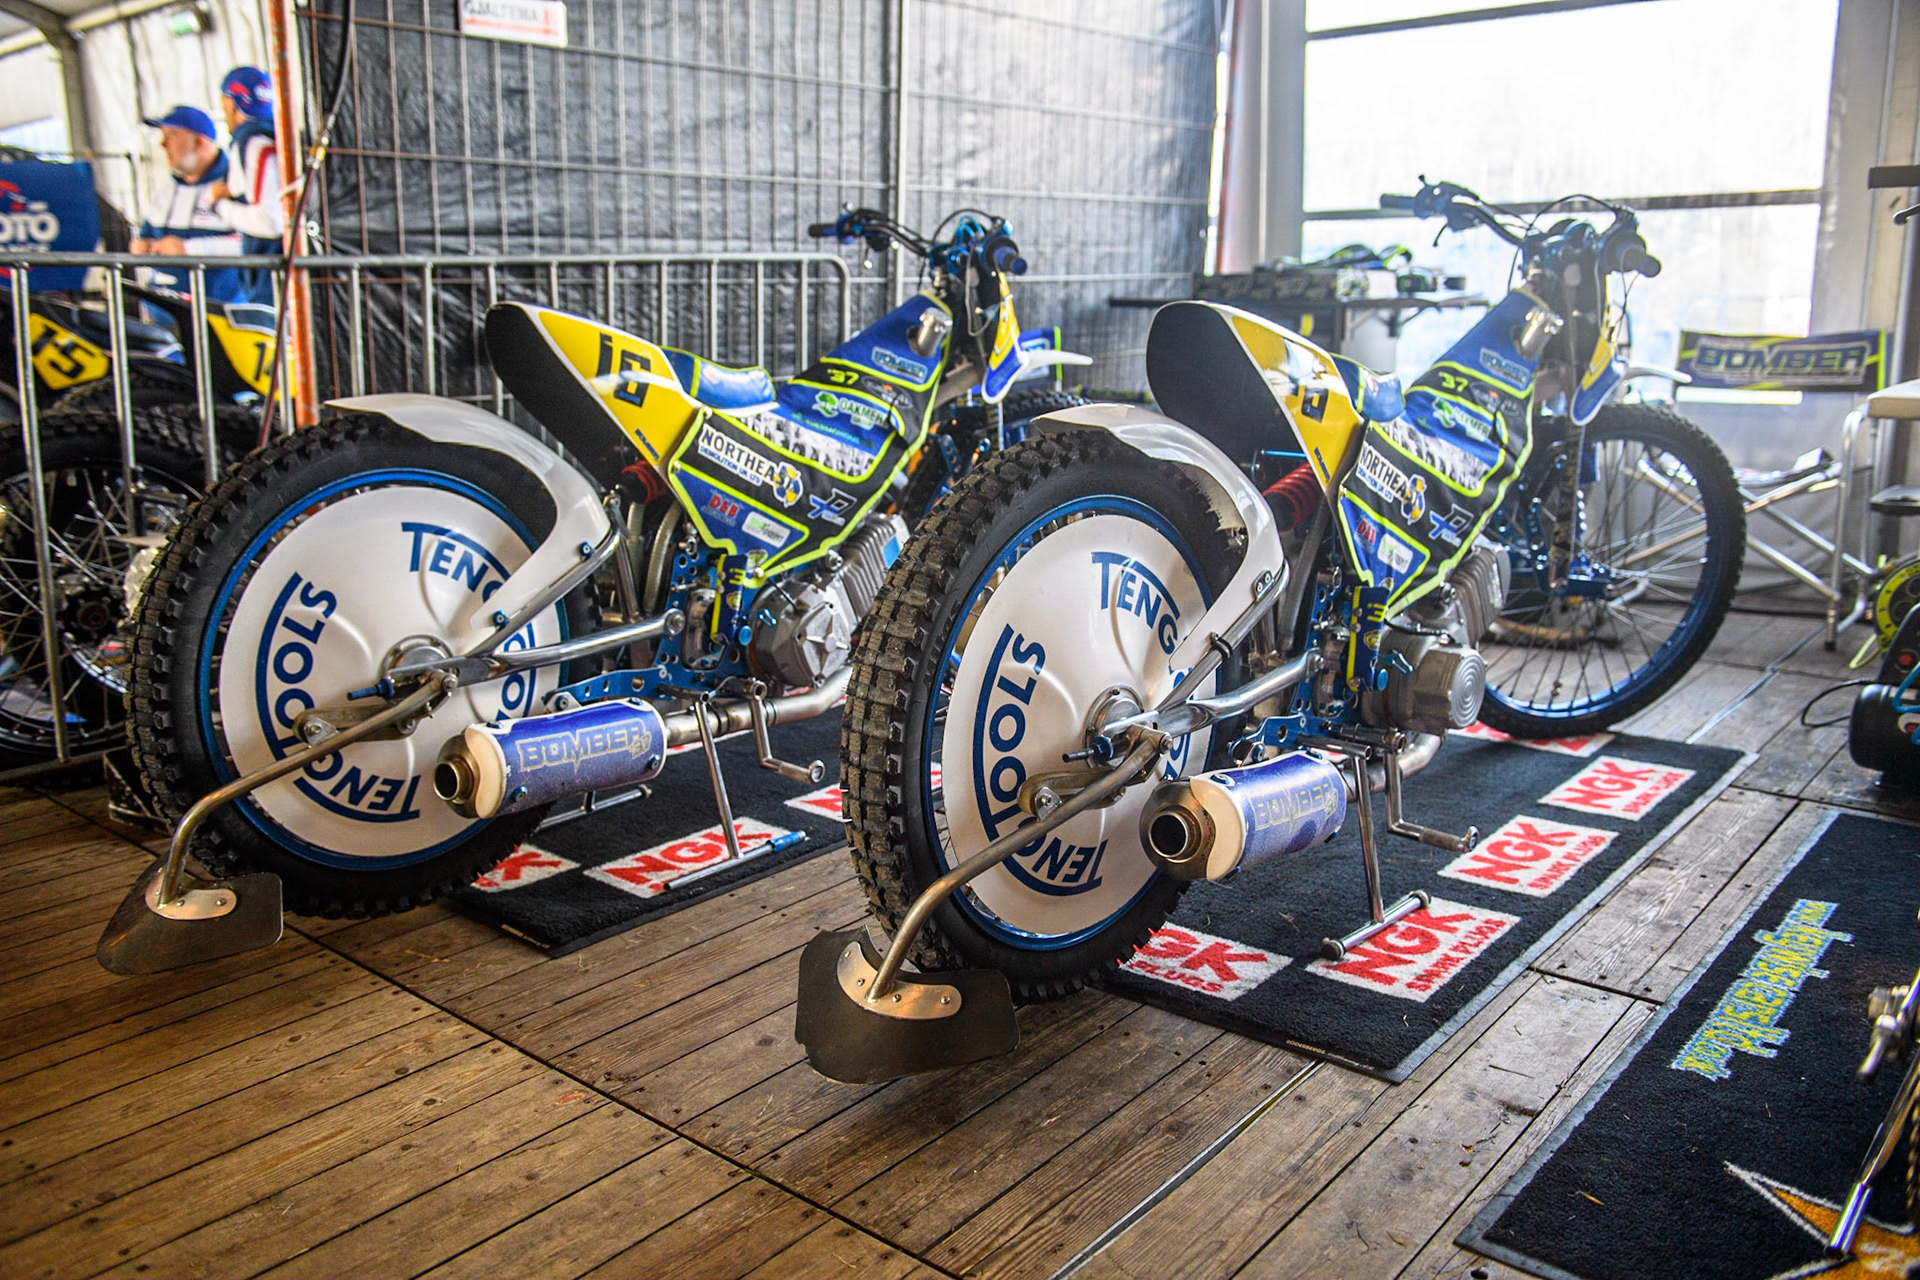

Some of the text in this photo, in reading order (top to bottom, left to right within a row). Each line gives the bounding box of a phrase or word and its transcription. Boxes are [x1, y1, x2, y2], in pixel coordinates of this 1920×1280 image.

[1696, 342, 1868, 374] BOMBER
[700, 446, 738, 471] DEMOLITION
[1091, 552, 1180, 655] TENG
[515, 718, 646, 773] BOMBER
[972, 623, 1047, 843] TOOLS
[1552, 762, 1657, 810] NGK
[603, 824, 773, 886] NGK
[1456, 822, 1578, 885] NGK
[1527, 835, 1606, 890] SPARK PLUGS
[1321, 909, 1477, 986] NGK
[1405, 917, 1507, 992] SPARK PLUGS
